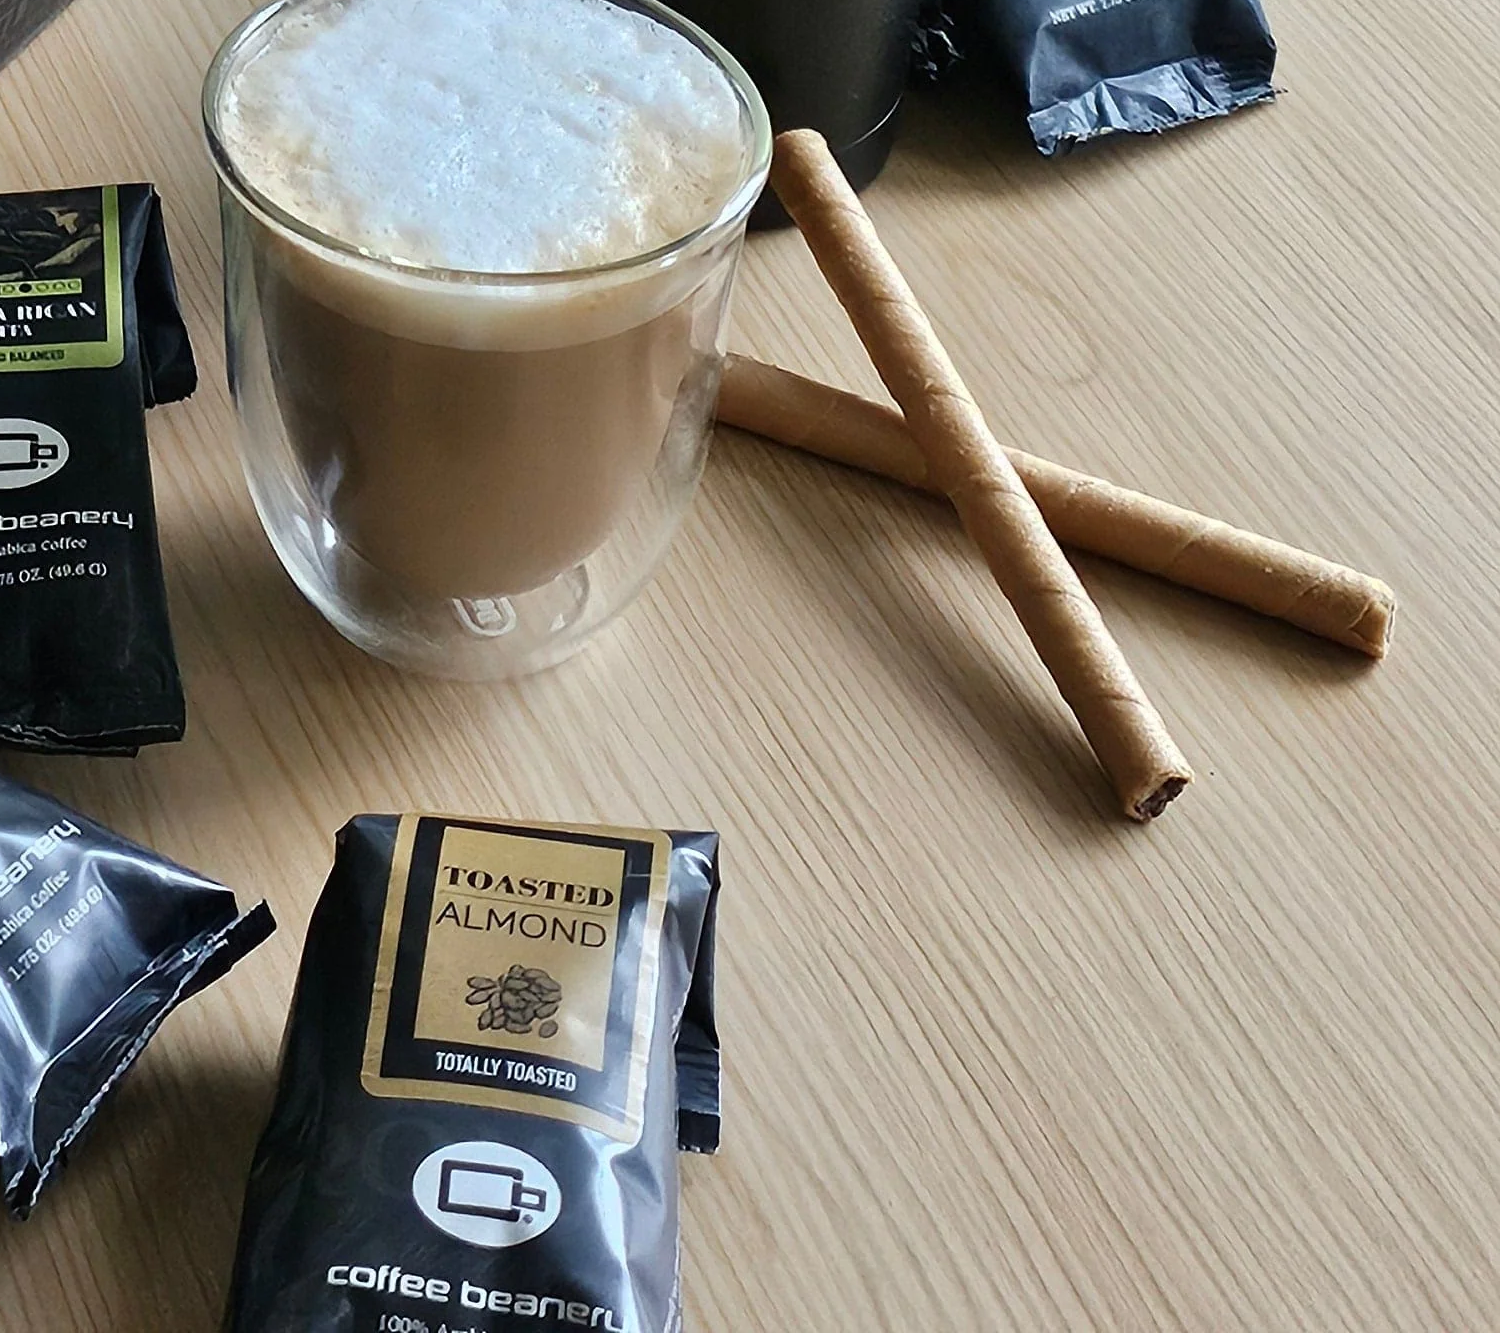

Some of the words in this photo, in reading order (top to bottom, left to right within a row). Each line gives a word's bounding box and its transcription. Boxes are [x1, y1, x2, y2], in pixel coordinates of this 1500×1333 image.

[17, 301, 97, 321] RICAN
[40, 536, 88, 552] Coffee
[30, 870, 71, 909] Coffee
[443, 865, 614, 908] TOASTED
[435, 901, 607, 949] ALMOND
[436, 1051, 502, 1077] TOTALLY
[506, 1060, 577, 1092] TOASTED
[327, 1264, 451, 1303] coffee
[459, 1280, 624, 1333] beanery
